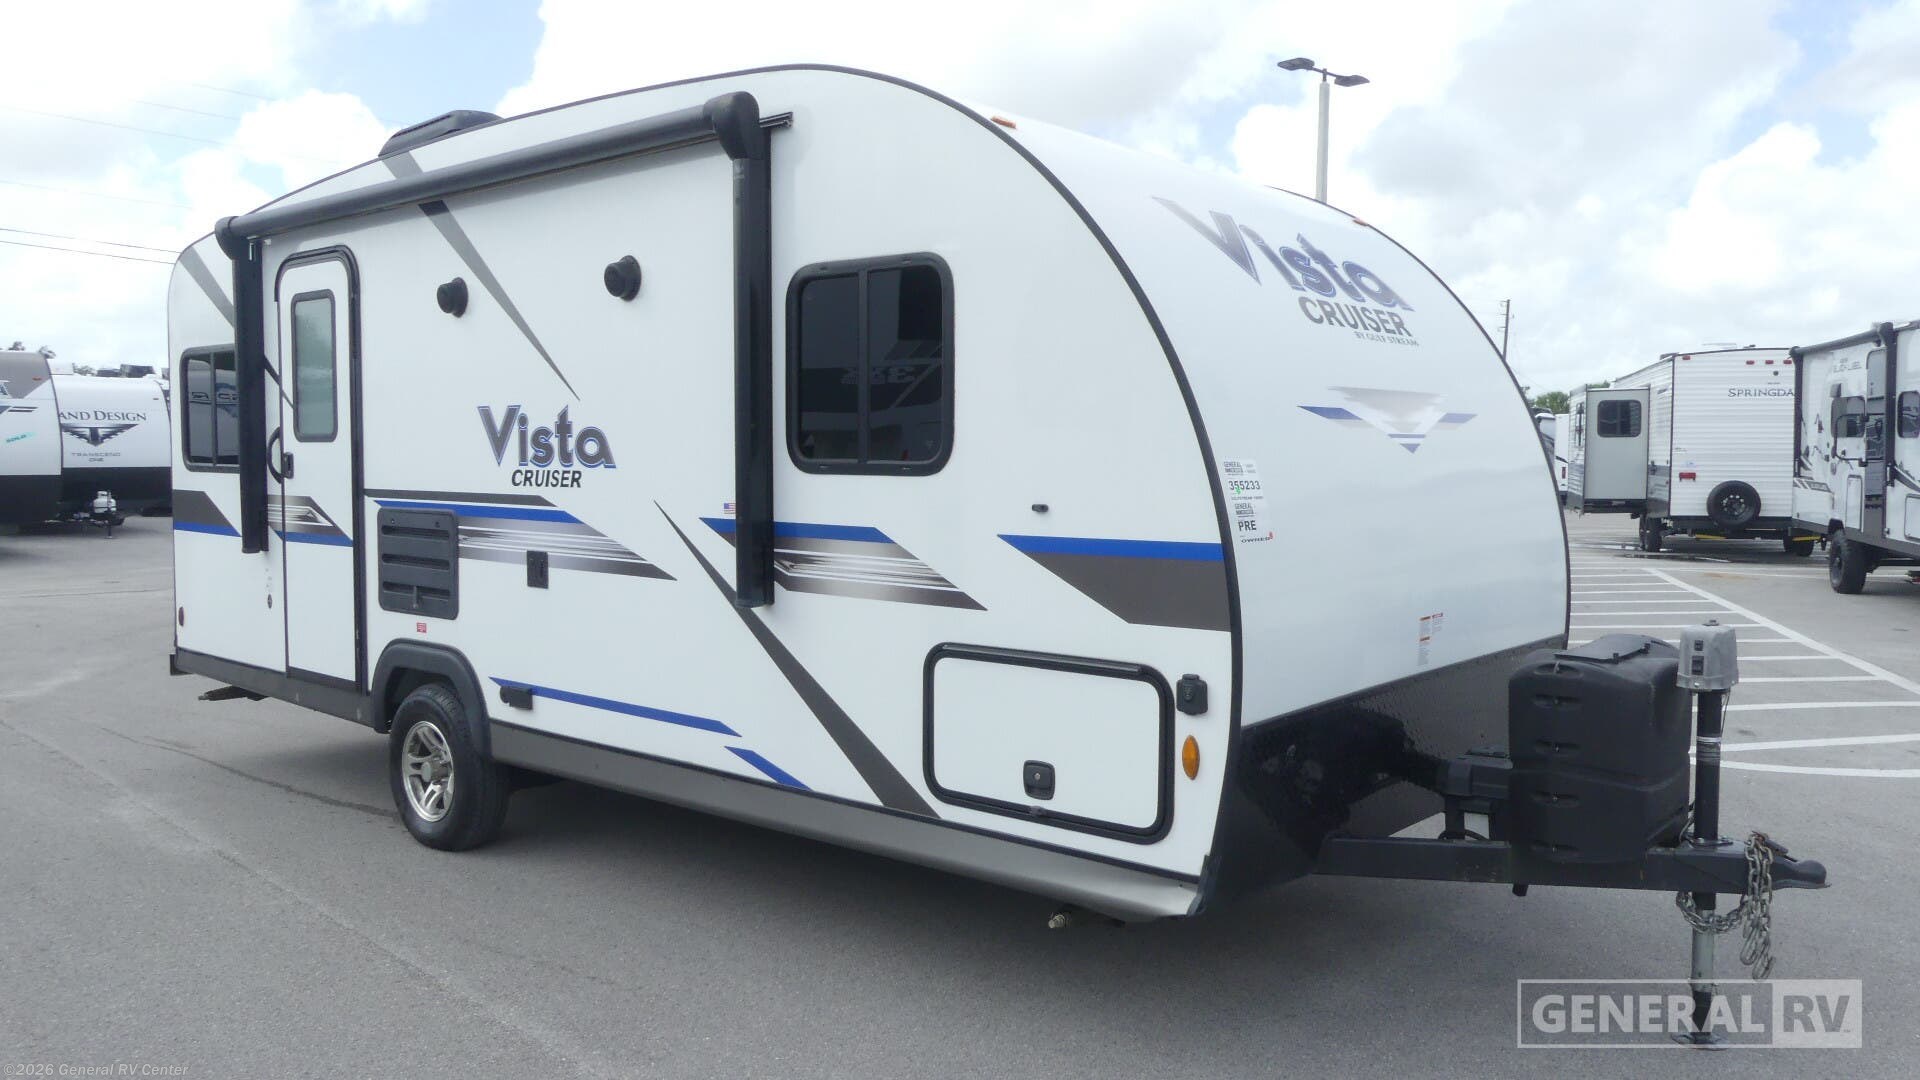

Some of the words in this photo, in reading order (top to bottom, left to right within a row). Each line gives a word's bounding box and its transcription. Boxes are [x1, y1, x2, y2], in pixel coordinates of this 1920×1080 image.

[1151, 195, 1416, 312] Vista
[1298, 296, 1413, 337] CRUISER
[94, 410, 147, 422] DESIGN
[476, 404, 617, 469] Vista
[511, 469, 582, 488] CRUISER
[1228, 480, 1261, 491] 355233
[1238, 520, 1257, 532] PRE
